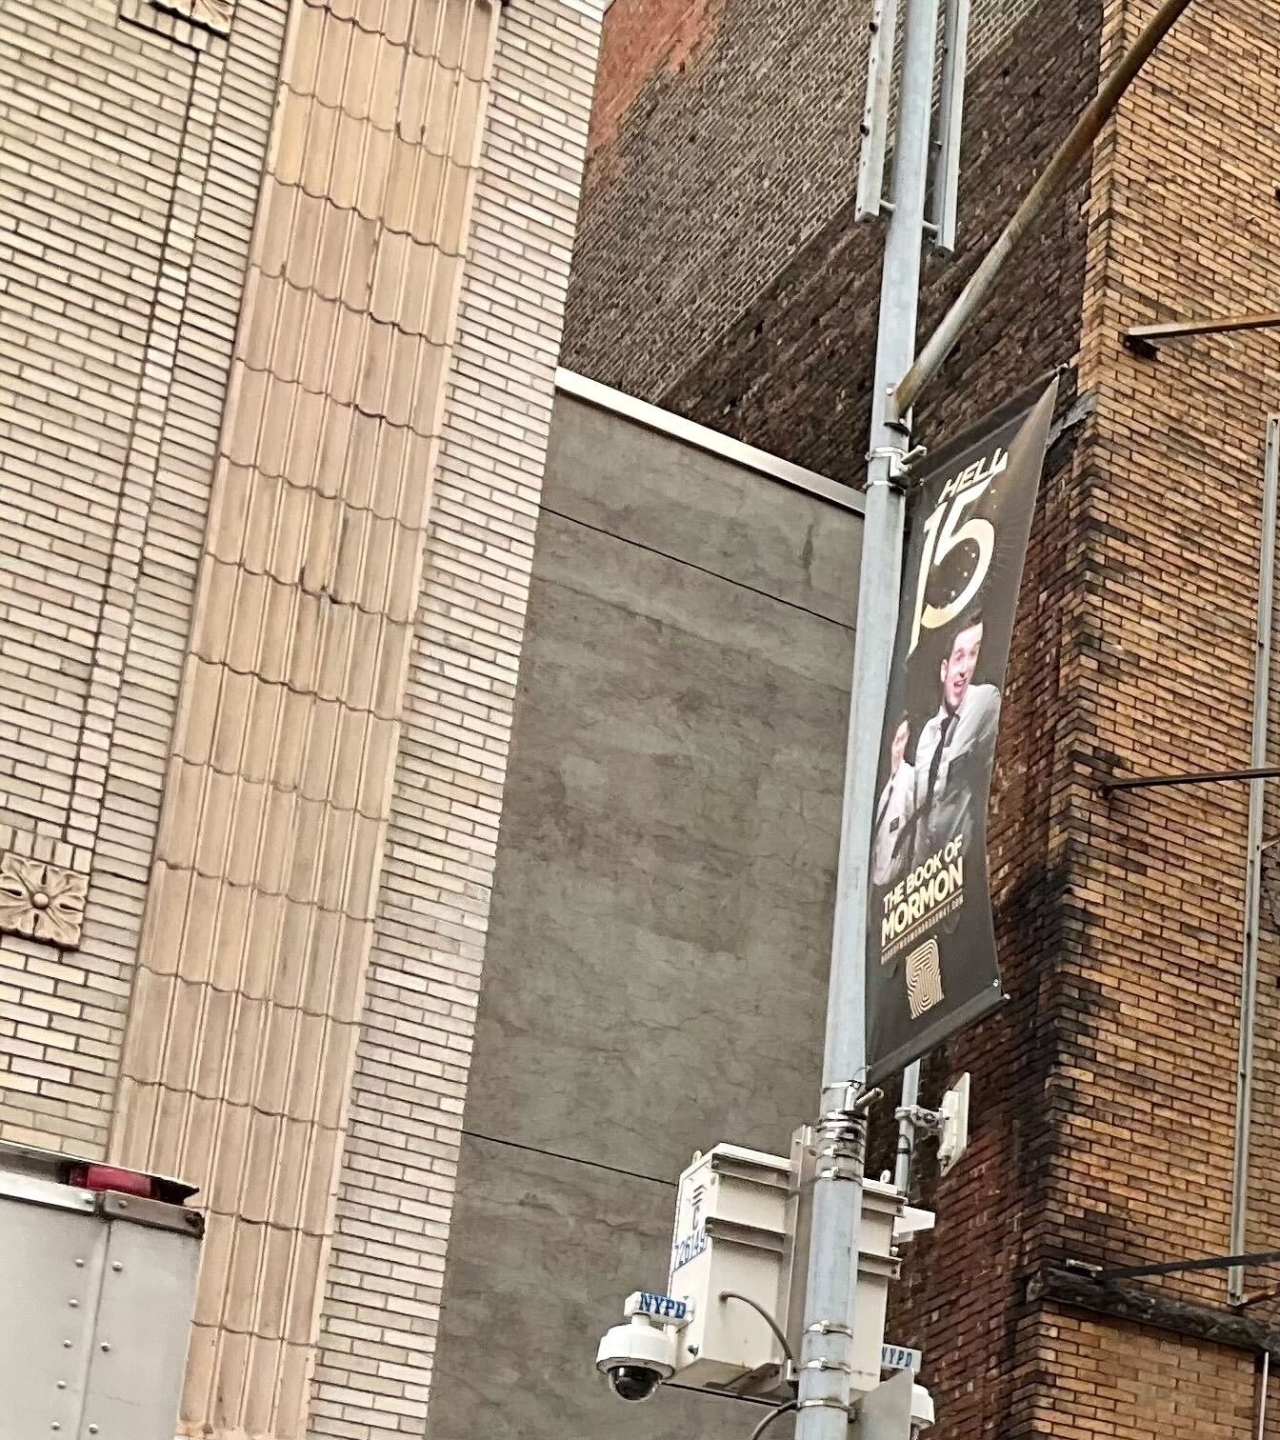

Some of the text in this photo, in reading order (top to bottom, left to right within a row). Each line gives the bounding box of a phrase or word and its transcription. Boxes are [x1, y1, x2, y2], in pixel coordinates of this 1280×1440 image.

[906, 474, 995, 658] 15
[881, 856, 963, 947] MORMON
[883, 834, 963, 914] THE BOOK OF
[639, 1292, 687, 1319] NYPD
